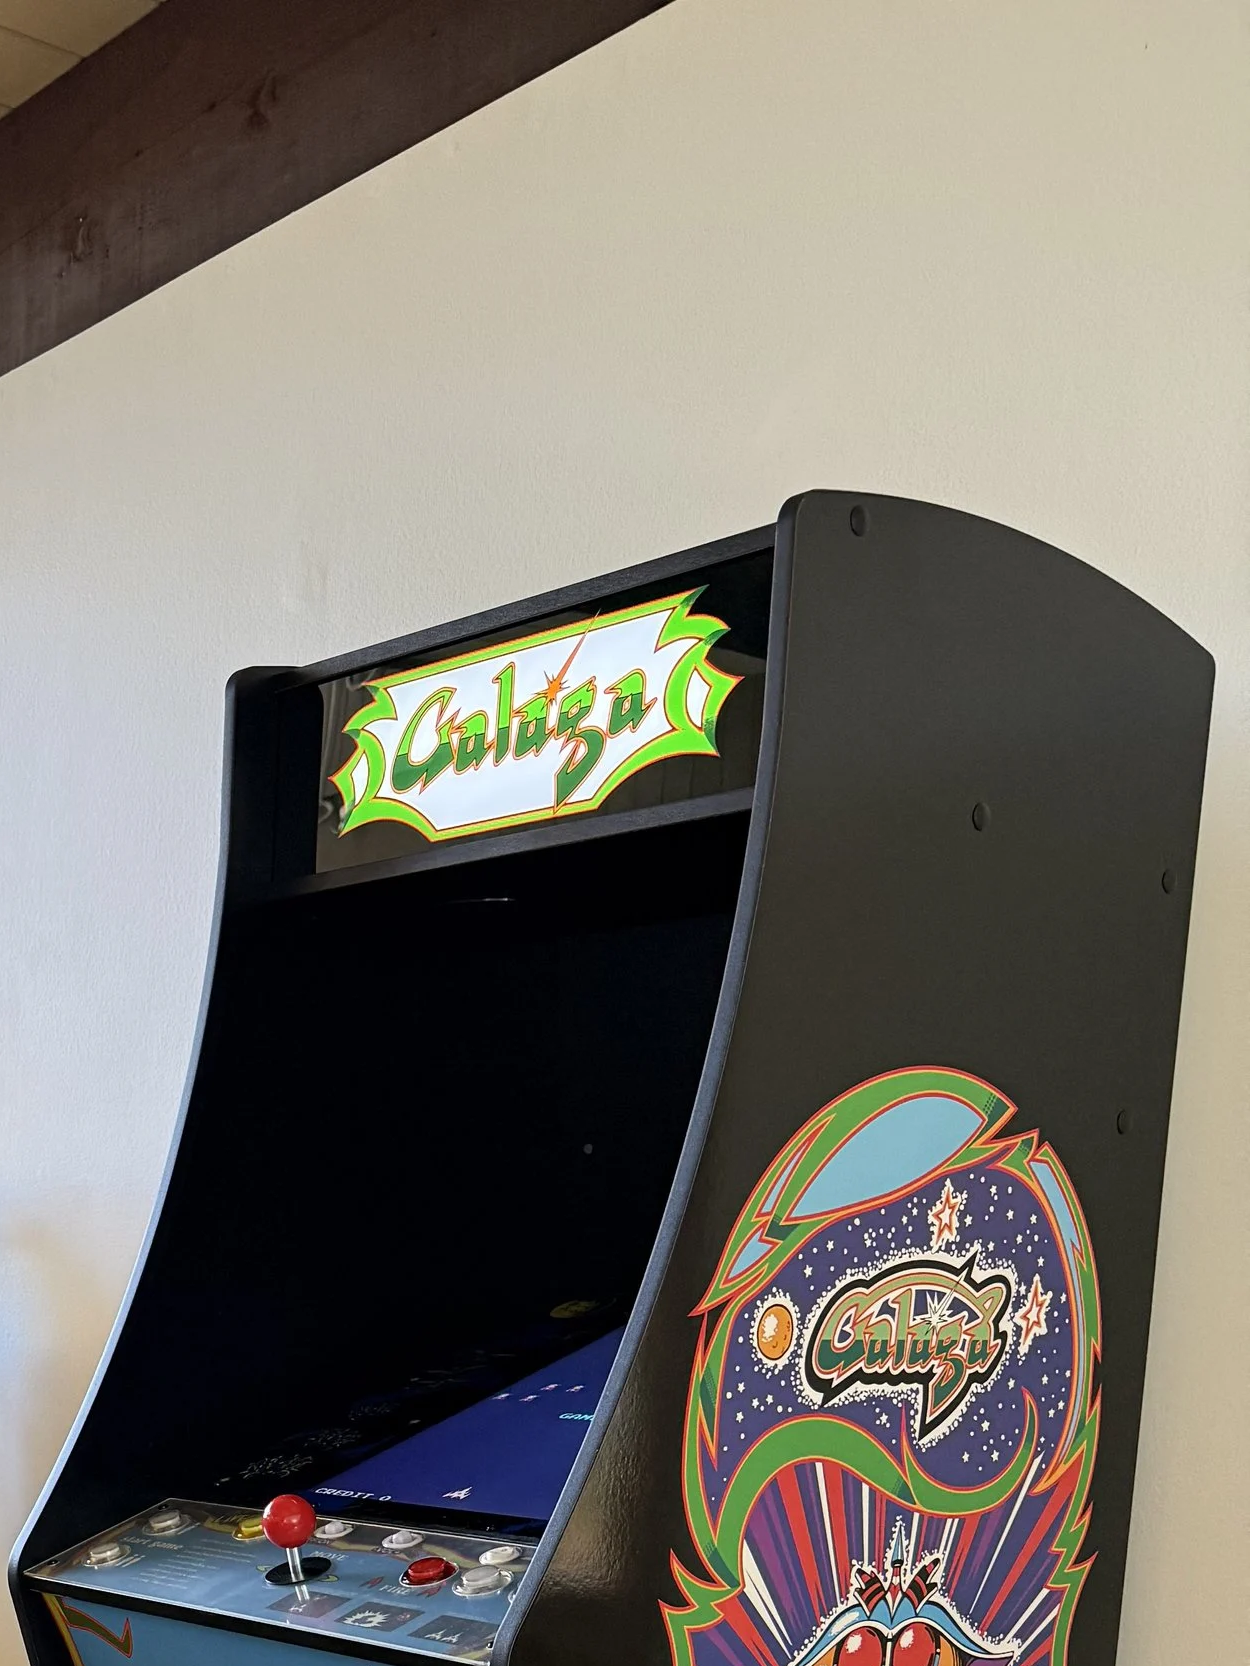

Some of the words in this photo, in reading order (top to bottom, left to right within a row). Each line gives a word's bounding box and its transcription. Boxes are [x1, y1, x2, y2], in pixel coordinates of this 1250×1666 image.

[559, 1412, 595, 1421] GAM
[315, 1488, 375, 1500] CREDIT
[310, 1550, 350, 1562] MOVE
[379, 1584, 414, 1596] FIRE
